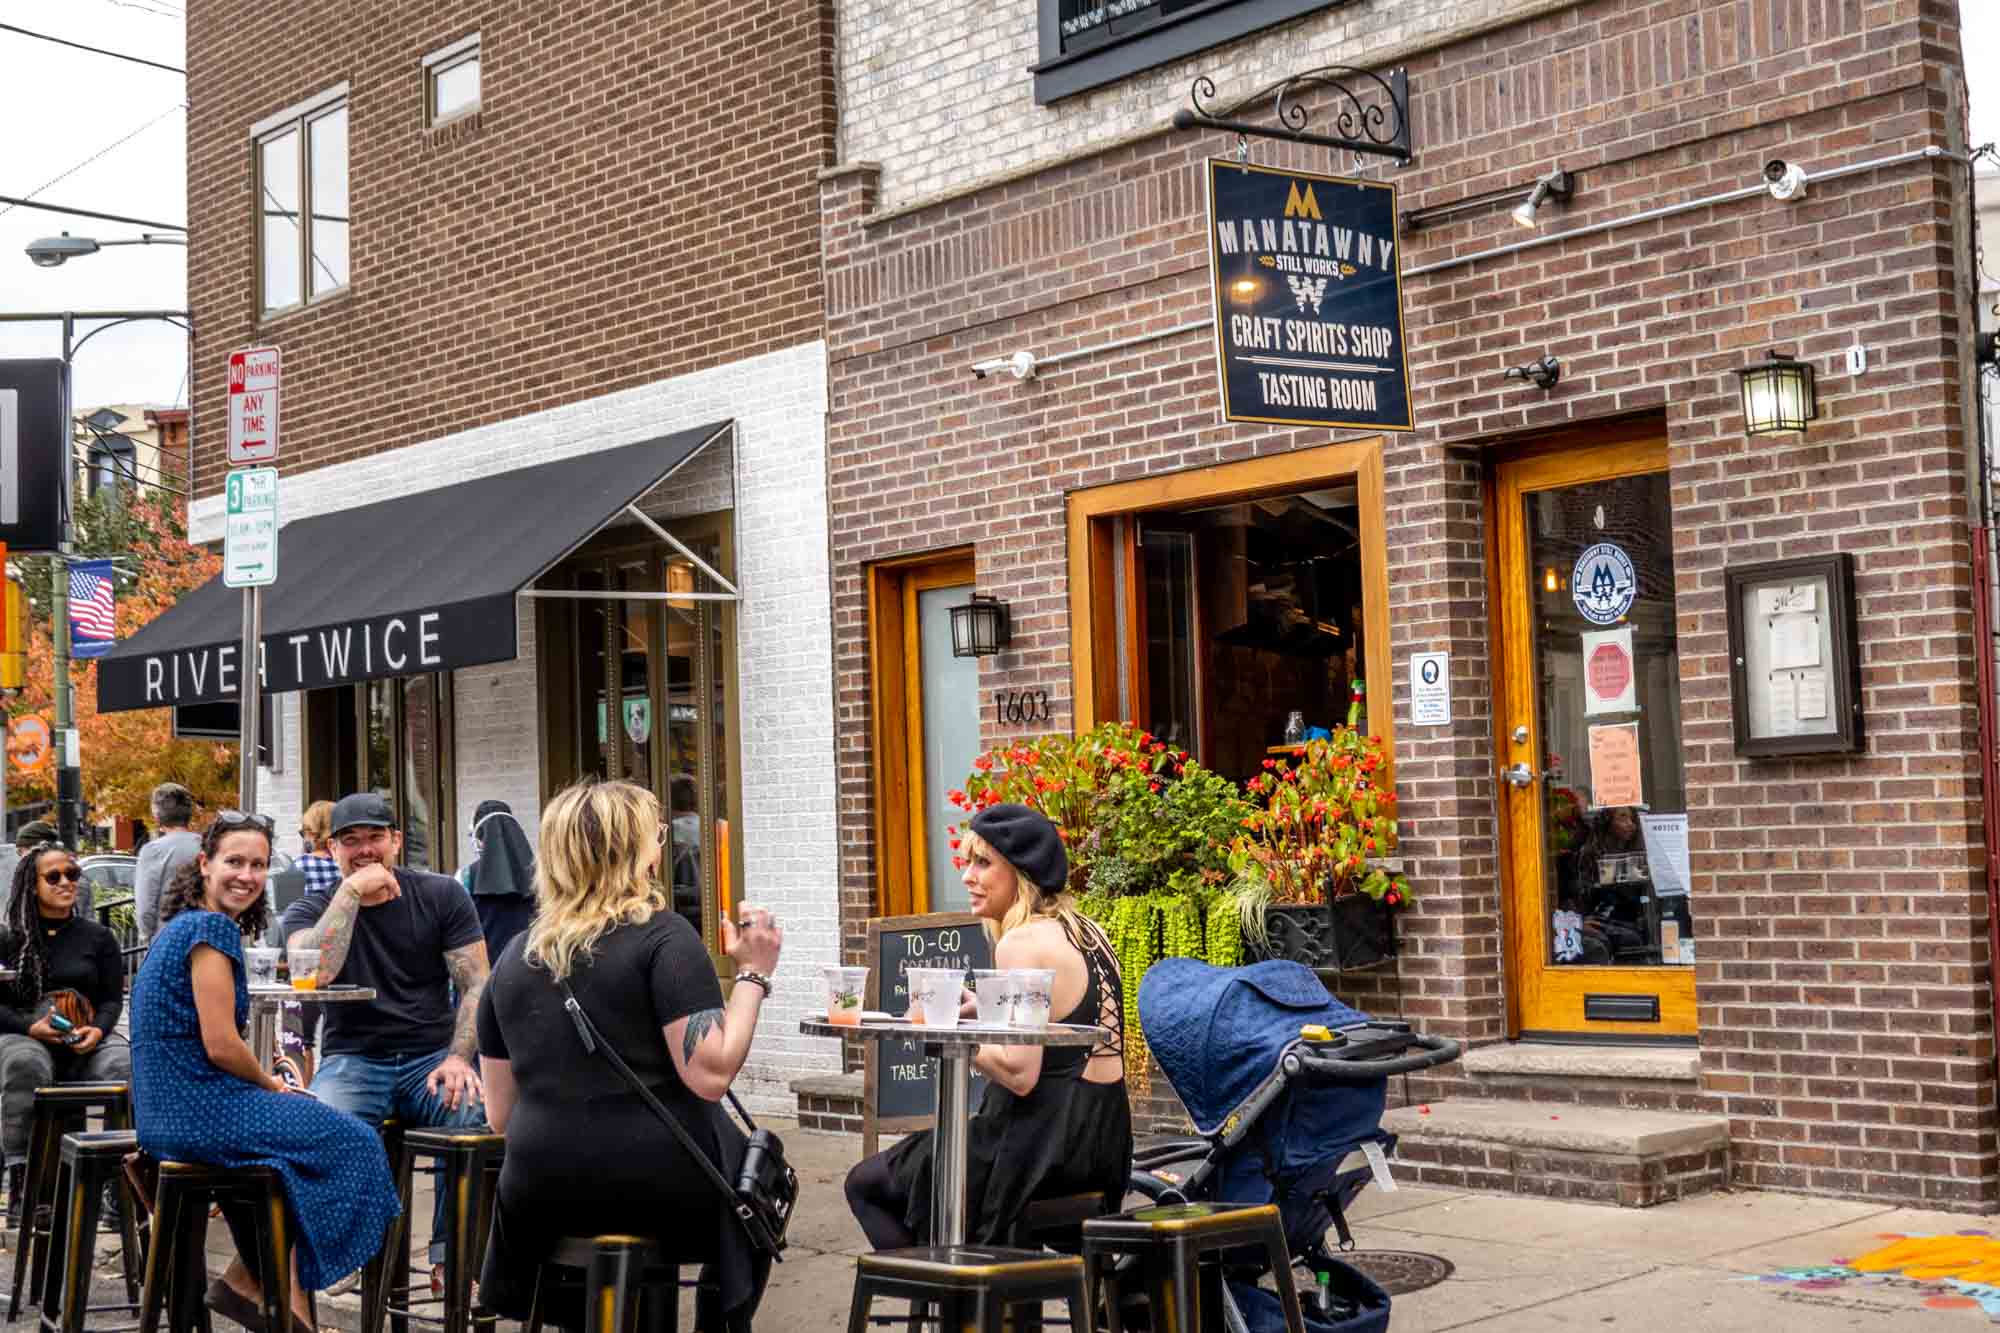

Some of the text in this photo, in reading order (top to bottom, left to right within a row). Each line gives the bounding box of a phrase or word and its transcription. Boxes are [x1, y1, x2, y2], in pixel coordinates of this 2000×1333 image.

[1217, 218, 1393, 272] MANATAWNY
[1275, 254, 1339, 276] STILL WORKS
[1231, 314, 1393, 359] CRAFT SPIRITS SHOP
[231, 361, 277, 385] NO PARKING
[243, 393, 264, 413] ANY
[1258, 372, 1377, 411] TASTING ROOM
[243, 415, 265, 432] TIME
[231, 479, 240, 507] 3
[289, 612, 441, 683] TWICE
[994, 690, 1049, 726] 1603
[902, 929, 961, 956] TO-GO
[889, 1063, 929, 1081] TABLE
